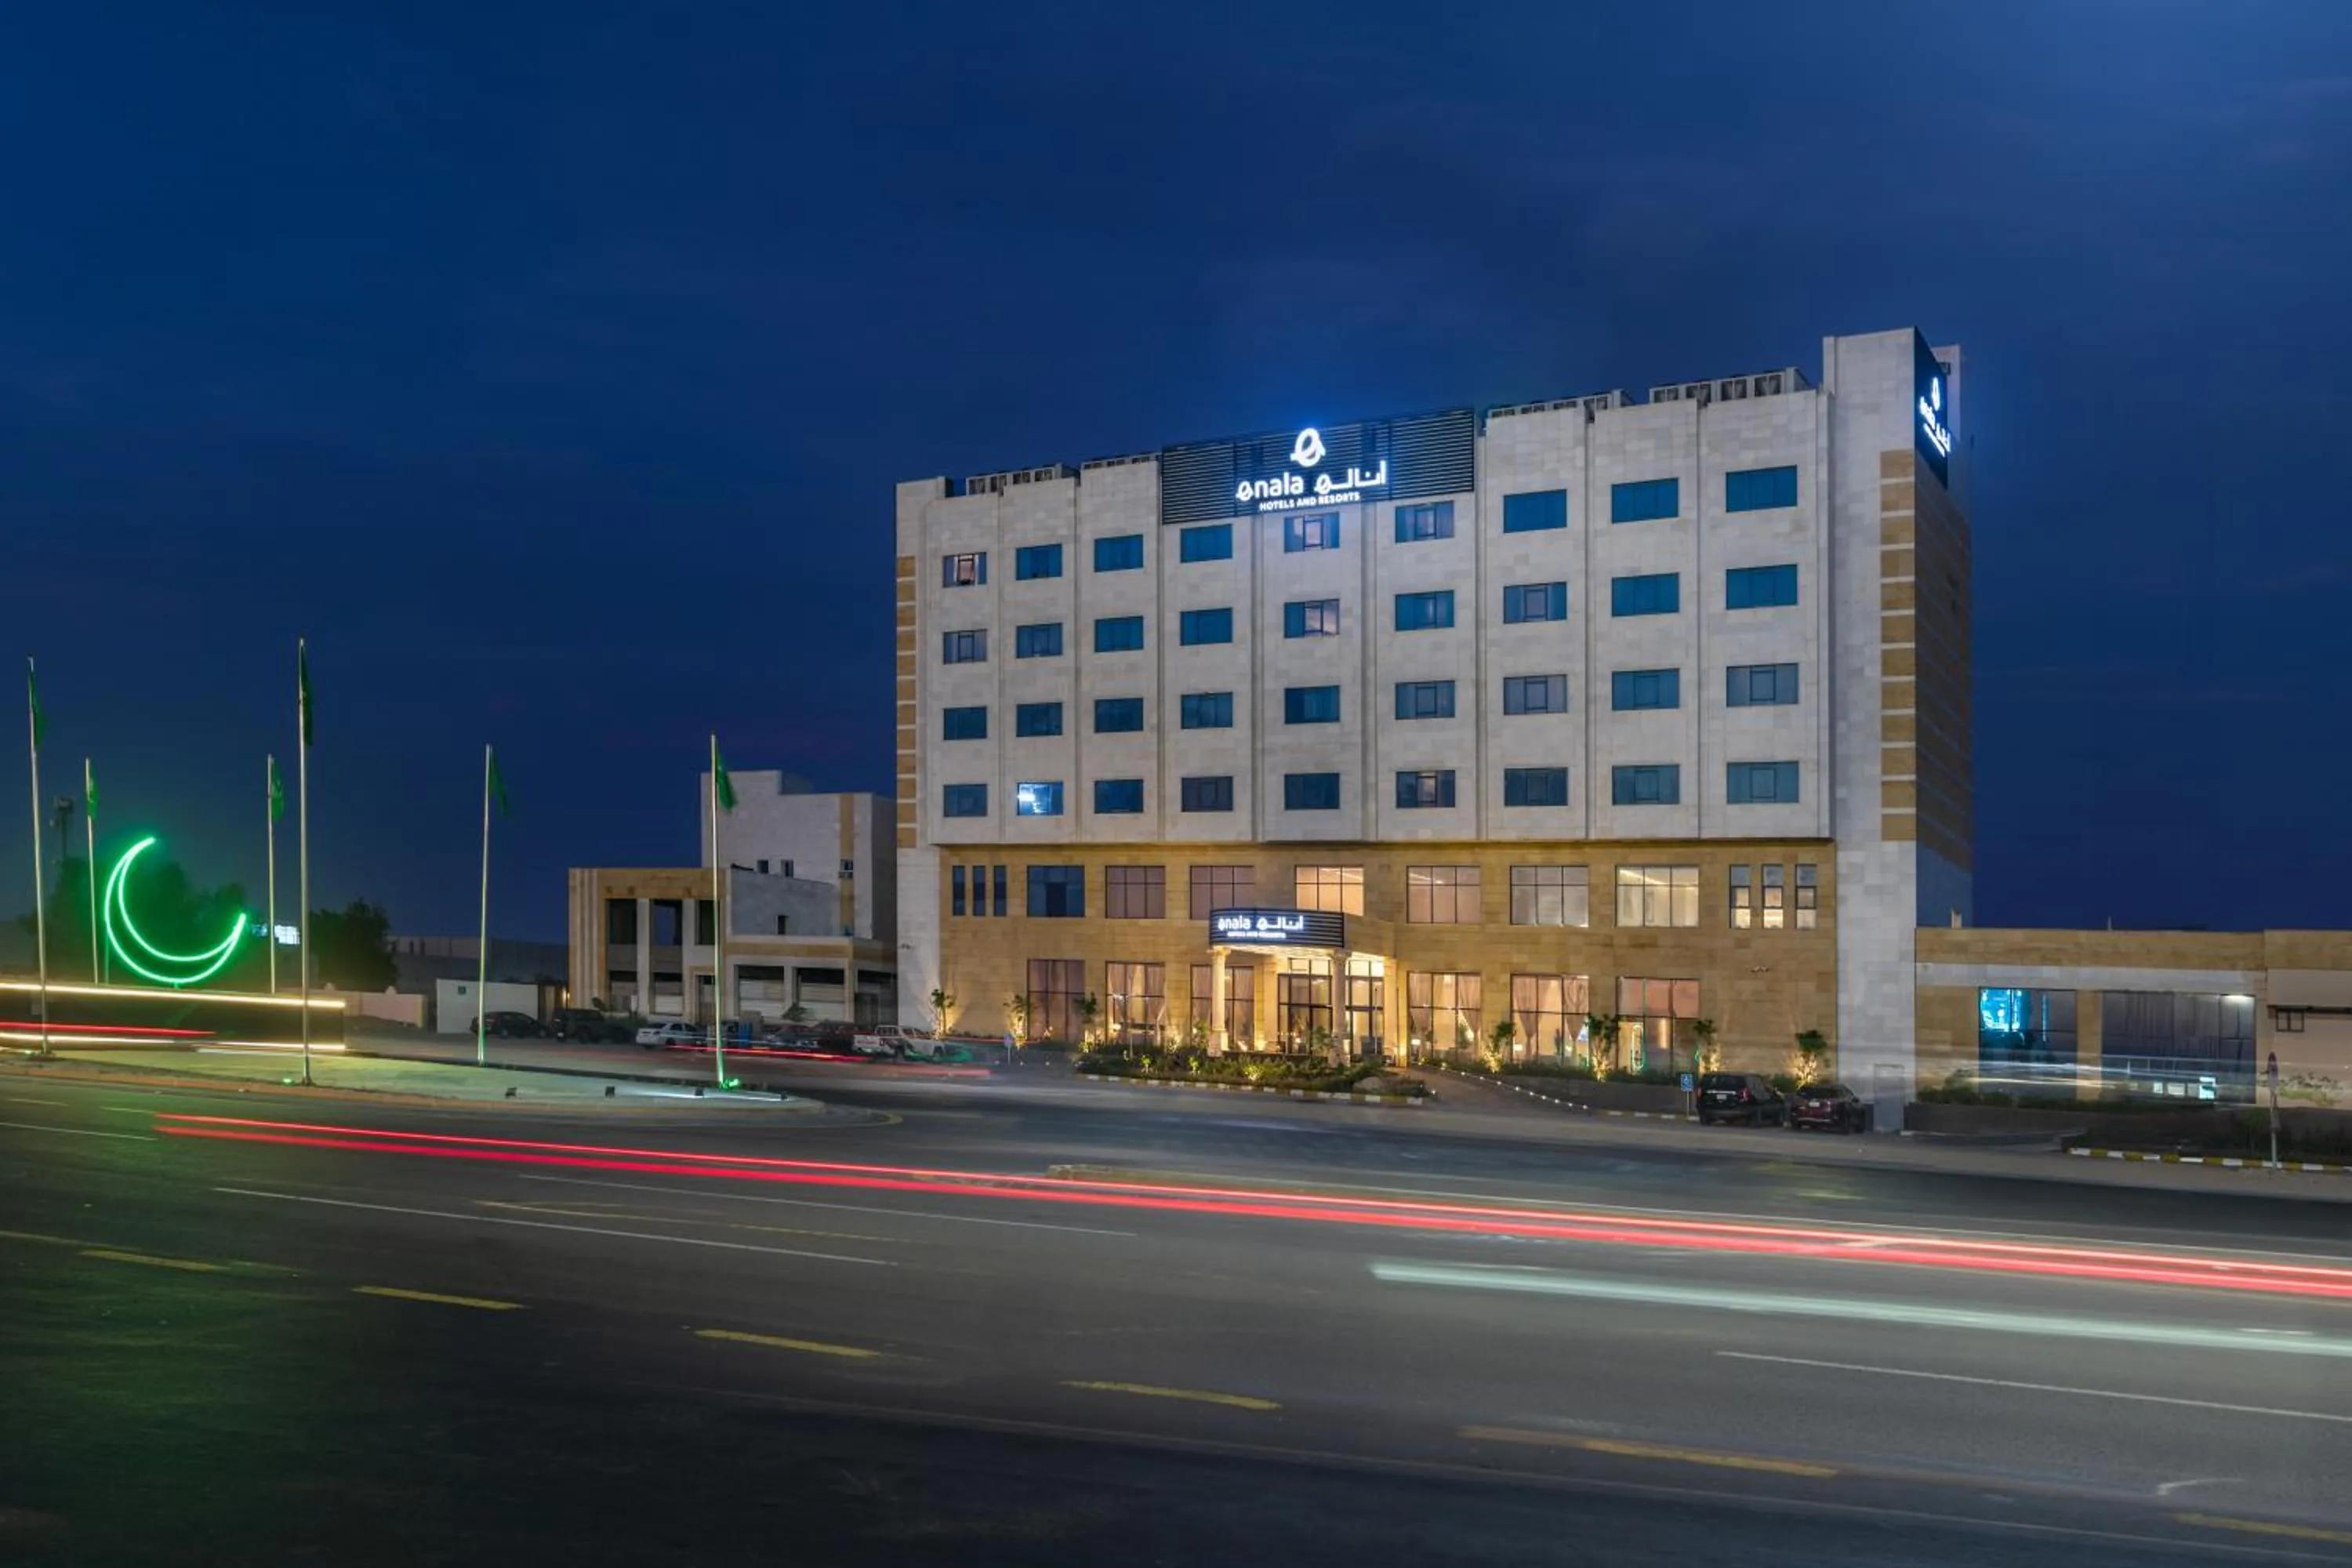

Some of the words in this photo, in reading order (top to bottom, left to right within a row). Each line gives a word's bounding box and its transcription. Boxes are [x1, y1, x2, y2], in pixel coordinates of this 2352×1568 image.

[1259, 498, 1295, 511] HOTELS
[1296, 495, 1317, 507] AND
[1318, 492, 1360, 506] RESORTS
